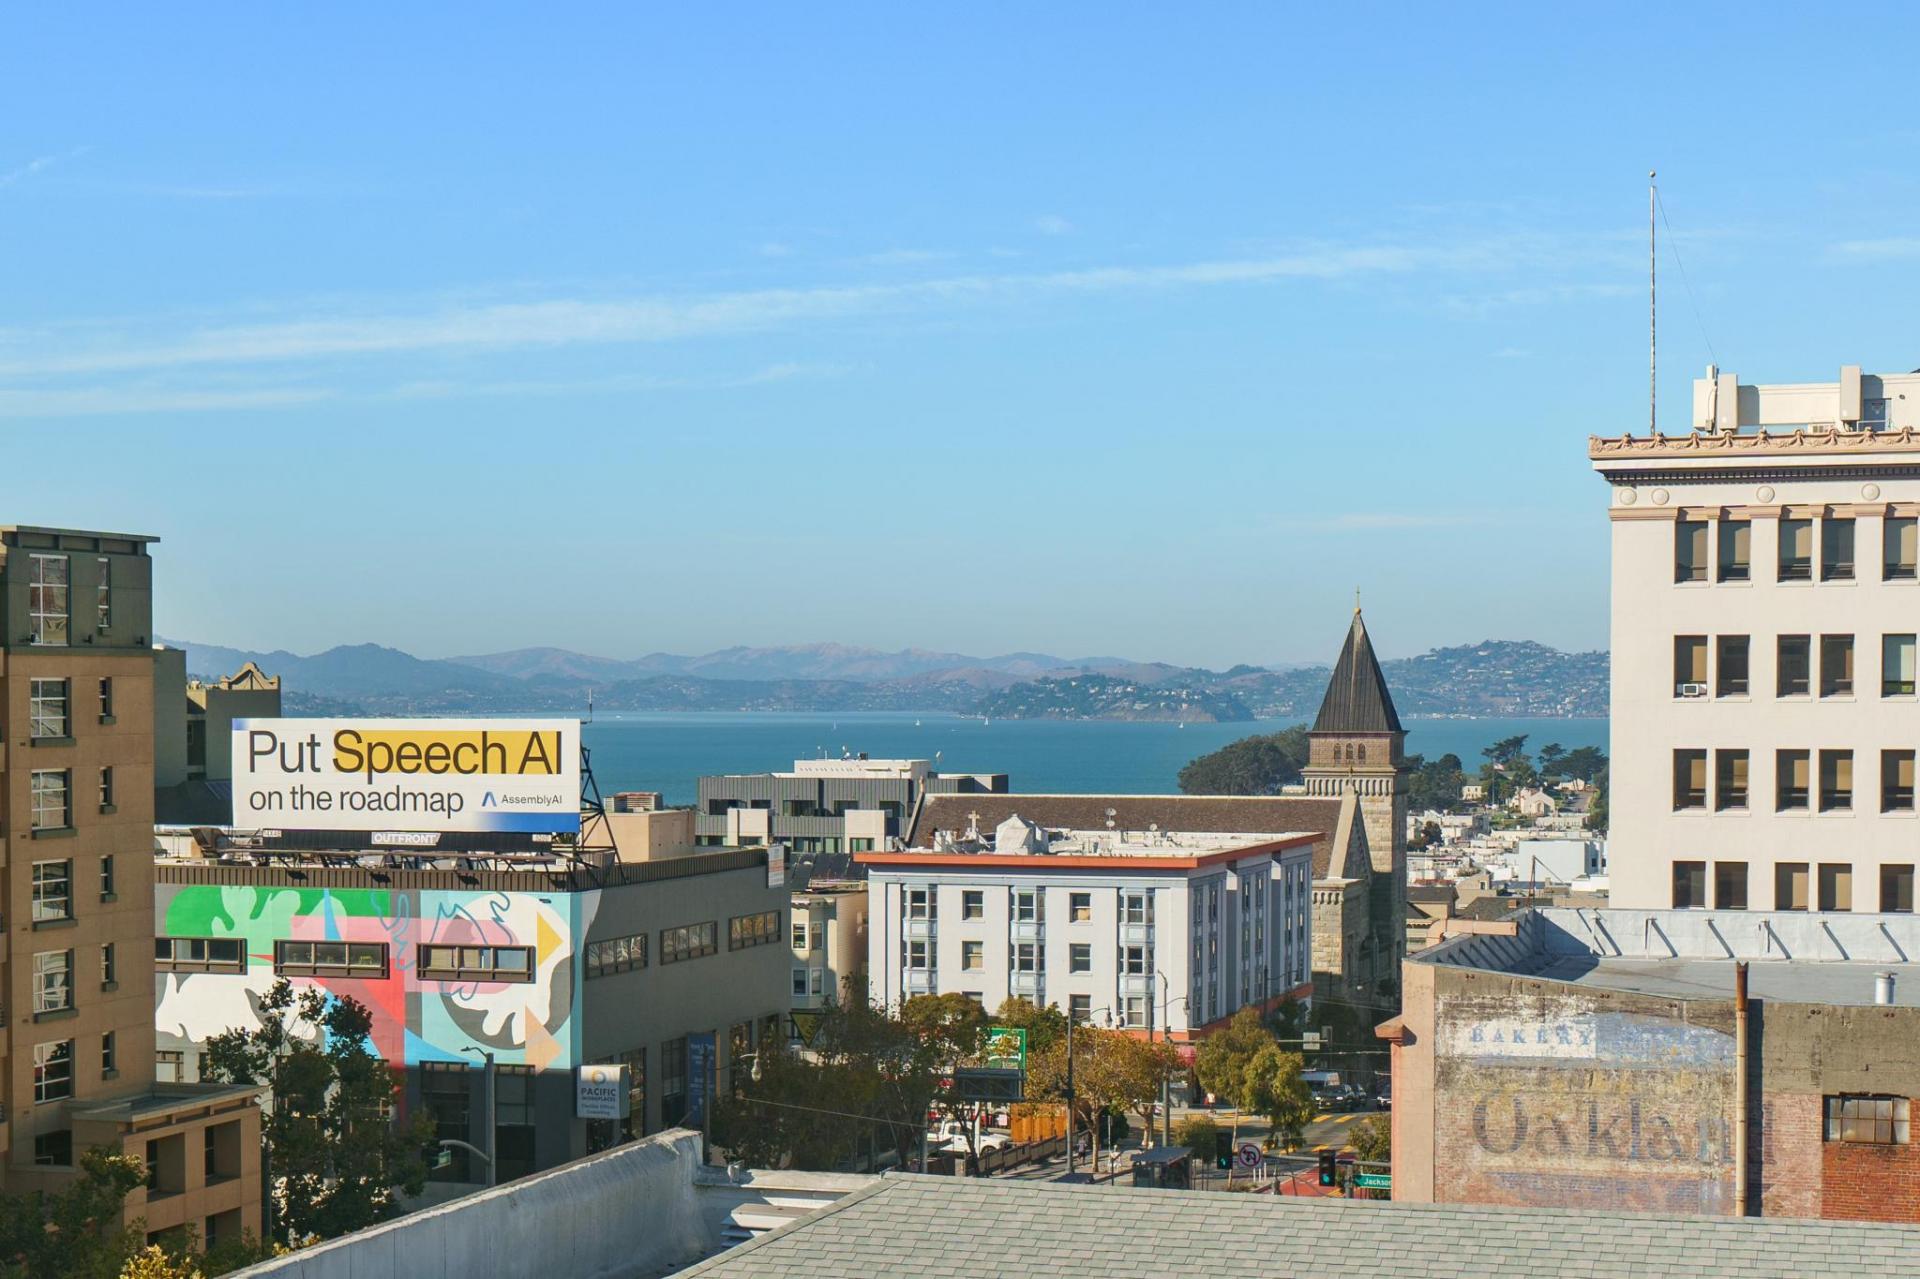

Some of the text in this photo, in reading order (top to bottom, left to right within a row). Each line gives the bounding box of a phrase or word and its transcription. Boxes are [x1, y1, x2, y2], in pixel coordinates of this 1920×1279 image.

[249, 729, 562, 785] Put Speech AI
[249, 784, 464, 819] on the roadmap
[501, 794, 563, 807] AssemblyAI
[374, 832, 437, 845] OUTFRONT
[1470, 1023, 1592, 1046] BAKERY
[580, 1087, 616, 1097] PACIFIC
